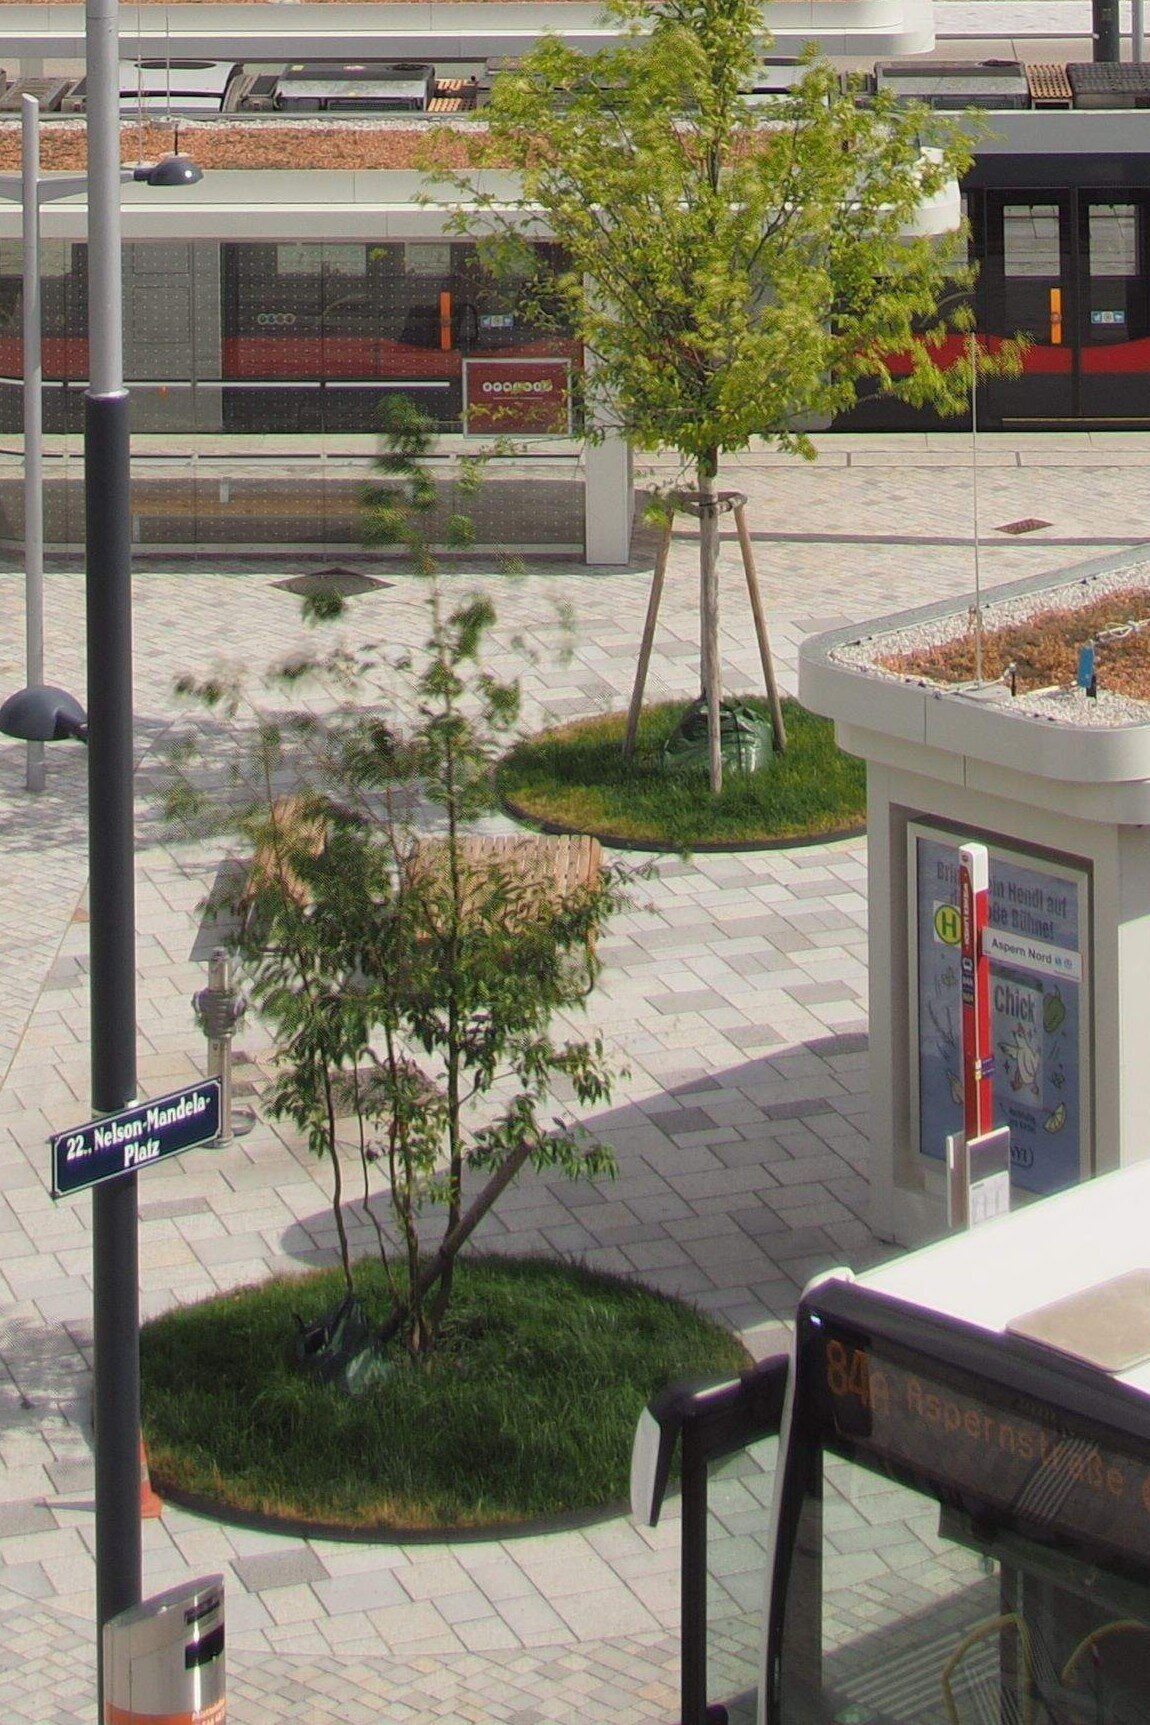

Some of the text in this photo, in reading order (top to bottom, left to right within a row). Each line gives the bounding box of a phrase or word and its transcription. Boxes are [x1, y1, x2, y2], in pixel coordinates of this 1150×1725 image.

[942, 910, 957, 939] H
[991, 938, 1026, 957] Aspern
[1028, 946, 1052, 964] Nord
[994, 984, 1035, 1022] Chick
[94, 1092, 211, 1151] Nelson-Mandela-
[124, 1138, 160, 1168] Platz
